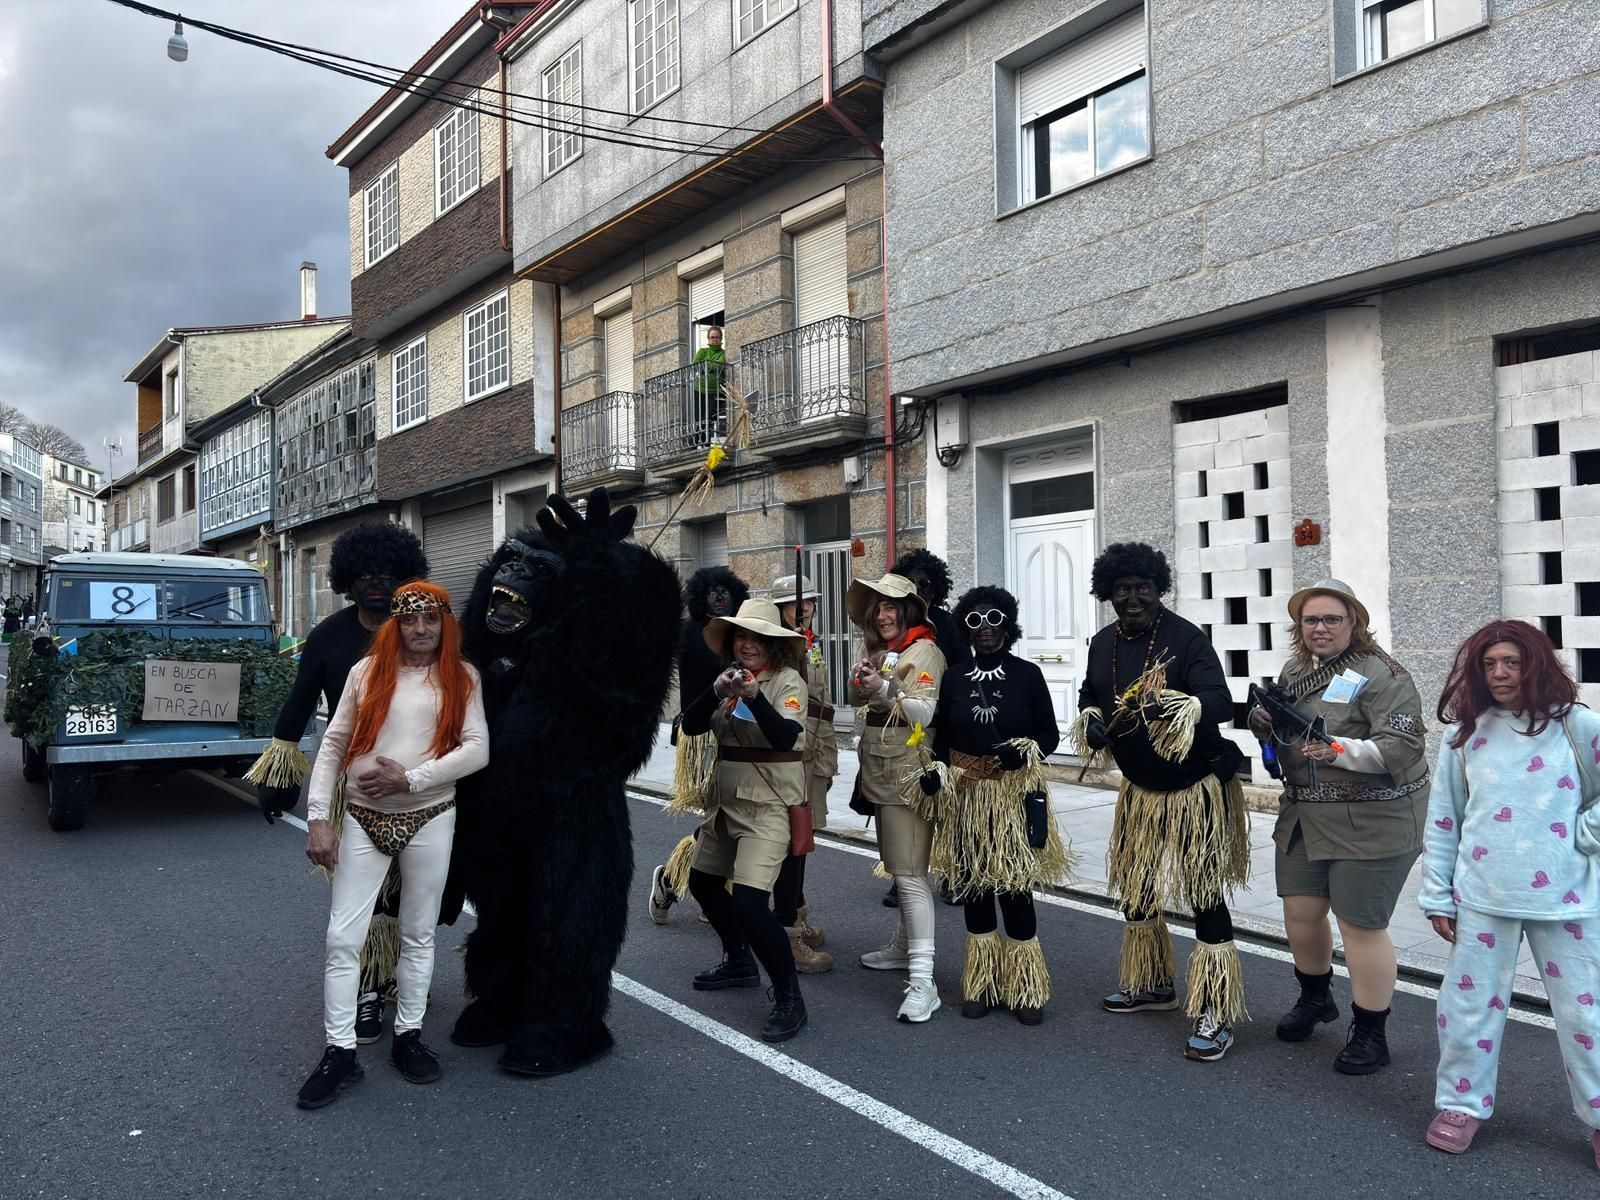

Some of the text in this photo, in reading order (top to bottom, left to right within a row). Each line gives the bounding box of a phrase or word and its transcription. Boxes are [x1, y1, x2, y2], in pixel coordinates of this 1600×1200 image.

[112, 586, 135, 615] 8
[151, 665, 217, 680] EN BUSCA
[174, 683, 196, 693] DE
[154, 696, 229, 718] TARZAN
[67, 719, 115, 734] 28163
